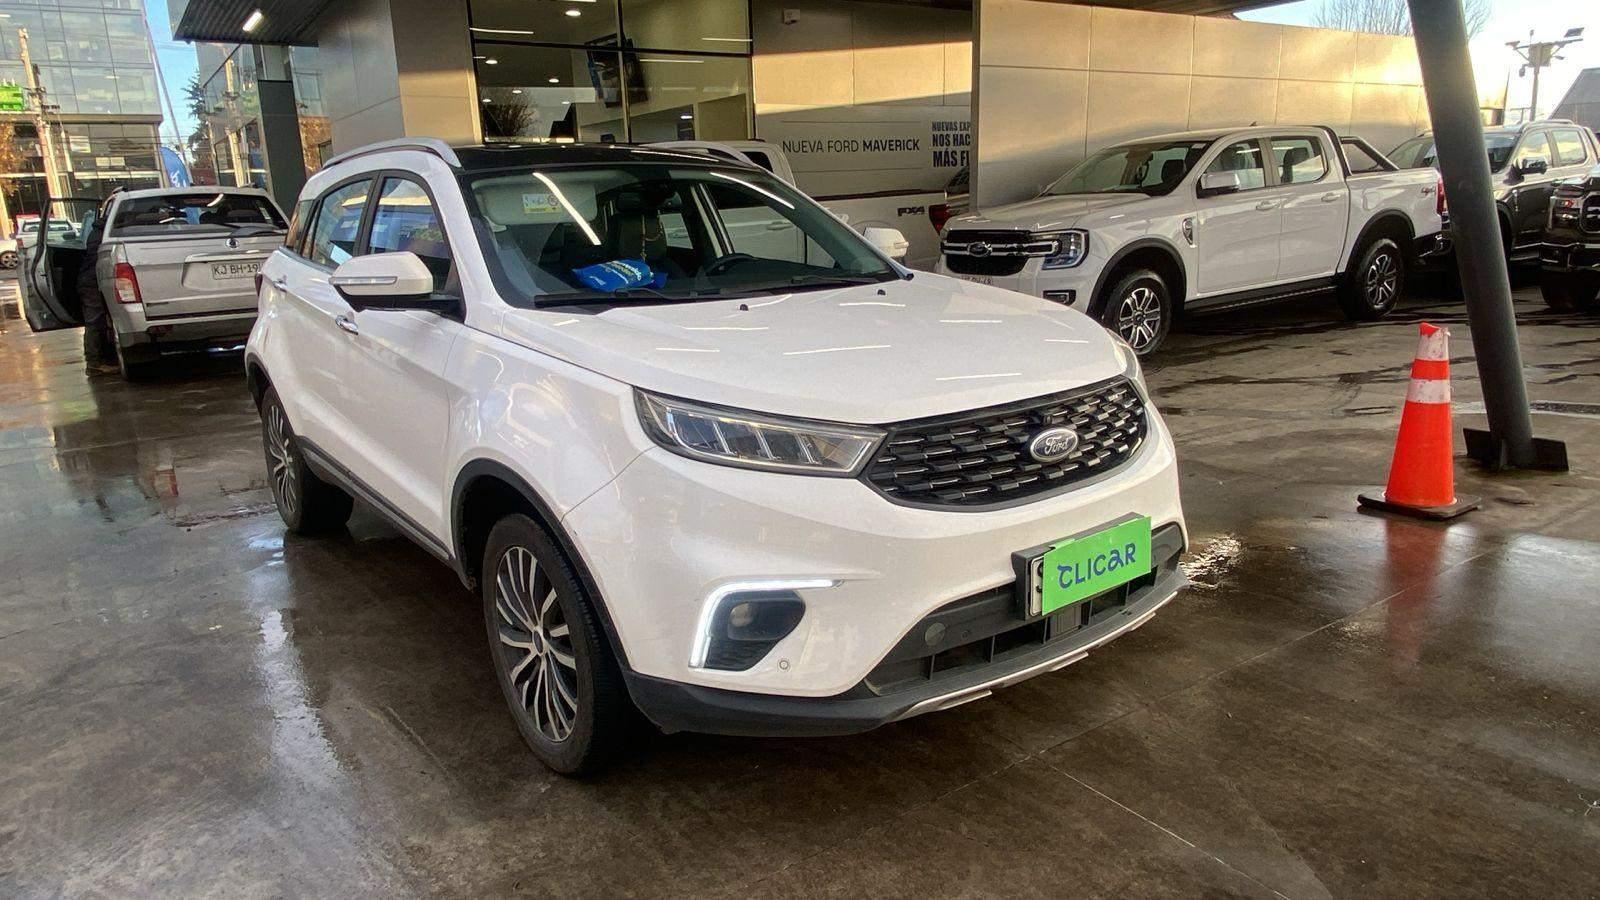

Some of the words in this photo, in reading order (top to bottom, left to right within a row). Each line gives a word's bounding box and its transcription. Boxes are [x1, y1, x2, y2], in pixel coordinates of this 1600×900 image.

[932, 121, 958, 131] NUEVAS
[782, 140, 823, 154] NUEVA
[827, 139, 859, 153] FORD
[862, 138, 920, 152] MAVERICK
[932, 133, 951, 147] NOS
[952, 133, 971, 147] HAC
[933, 148, 958, 168] MÁS
[214, 264, 227, 275] KJ
[1044, 435, 1074, 455] Ford
